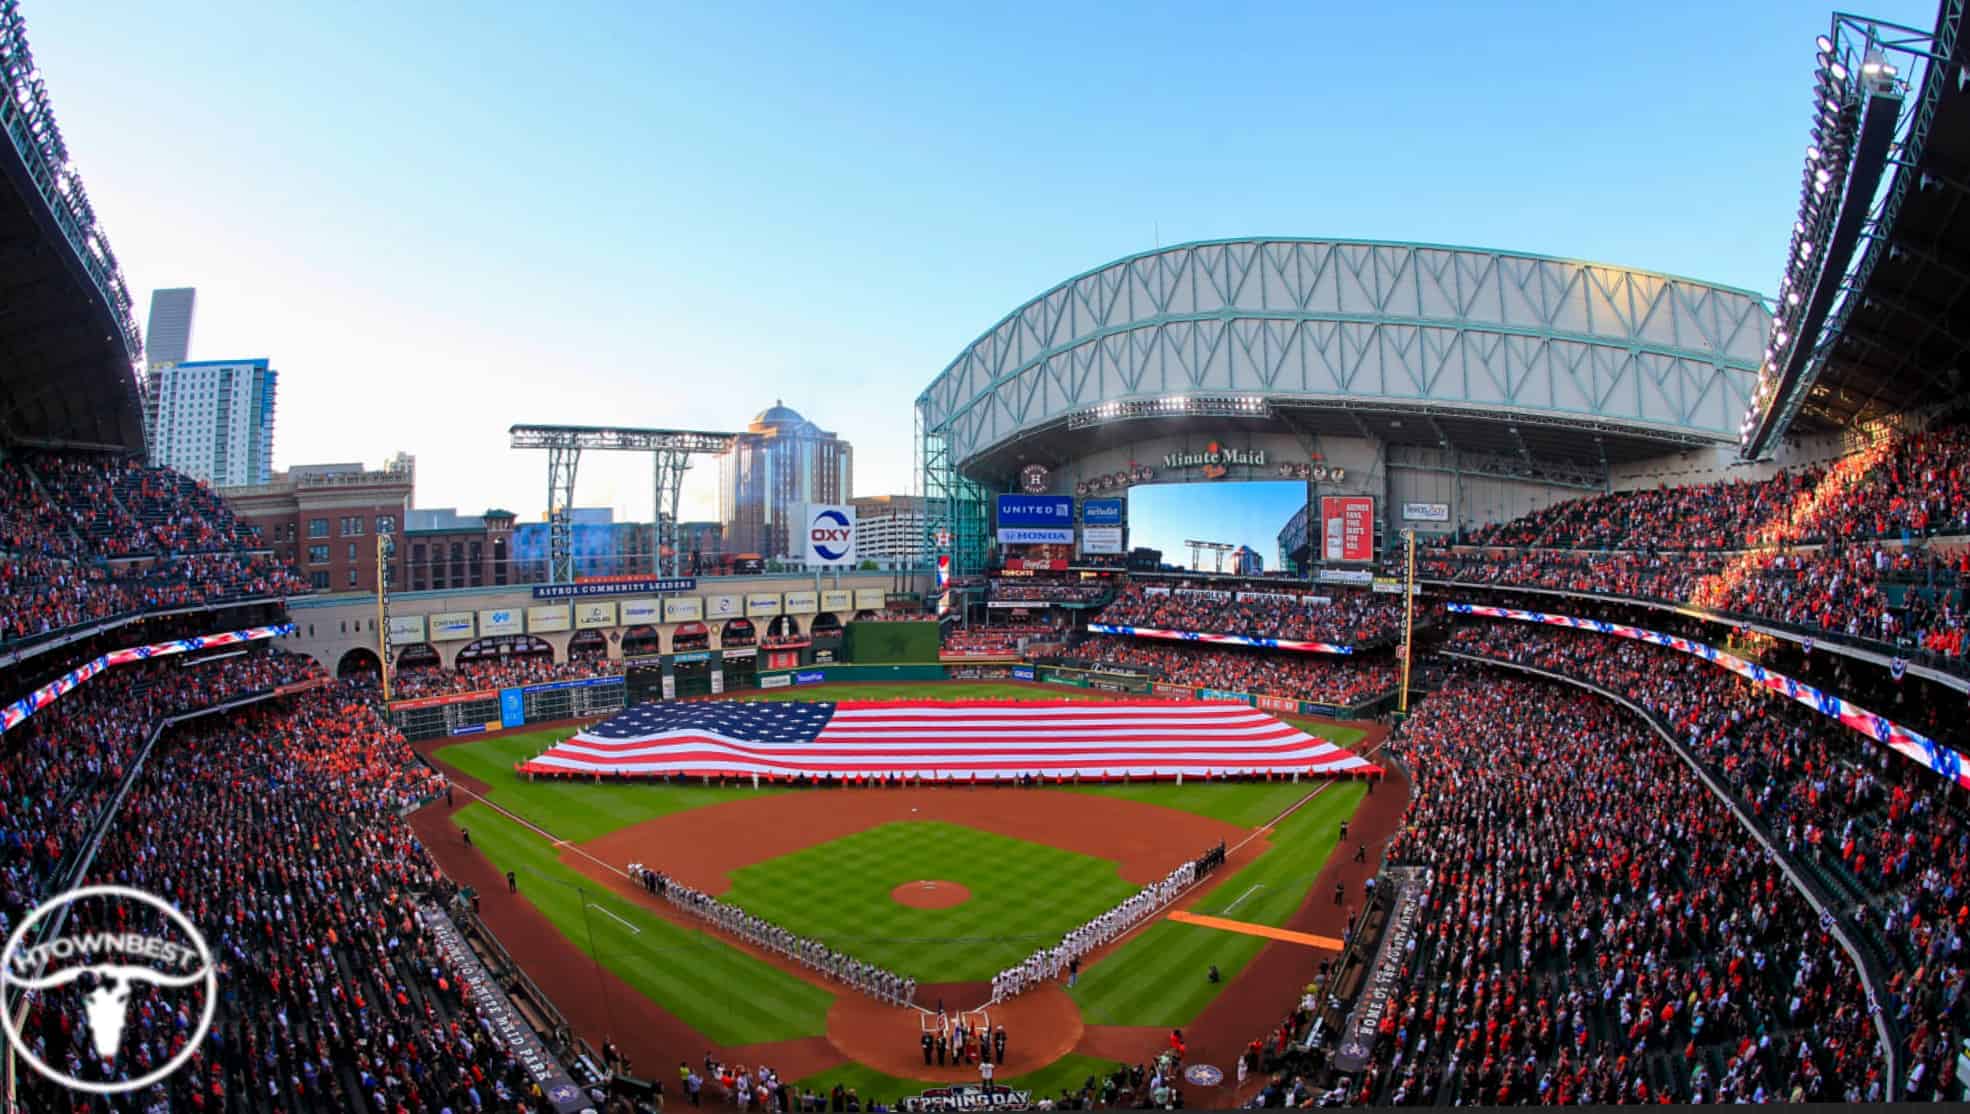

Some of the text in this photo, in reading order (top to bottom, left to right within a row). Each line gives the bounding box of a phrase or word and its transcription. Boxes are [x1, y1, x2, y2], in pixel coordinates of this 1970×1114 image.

[1163, 449, 1265, 467] Minute Maid
[1003, 506, 1053, 514] UNITED
[811, 529, 850, 541] OXY
[1017, 532, 1066, 540] HONDA
[539, 580, 692, 597] ASTROS COMMUNITY LEADERS
[1382, 963, 1397, 984] THE
[1375, 985, 1390, 1000] OF
[1360, 1003, 1384, 1035] HOME
[496, 1014, 525, 1047] MAID
[519, 1048, 552, 1082] PARK
[903, 1090, 1032, 1112] OPENING DAY
